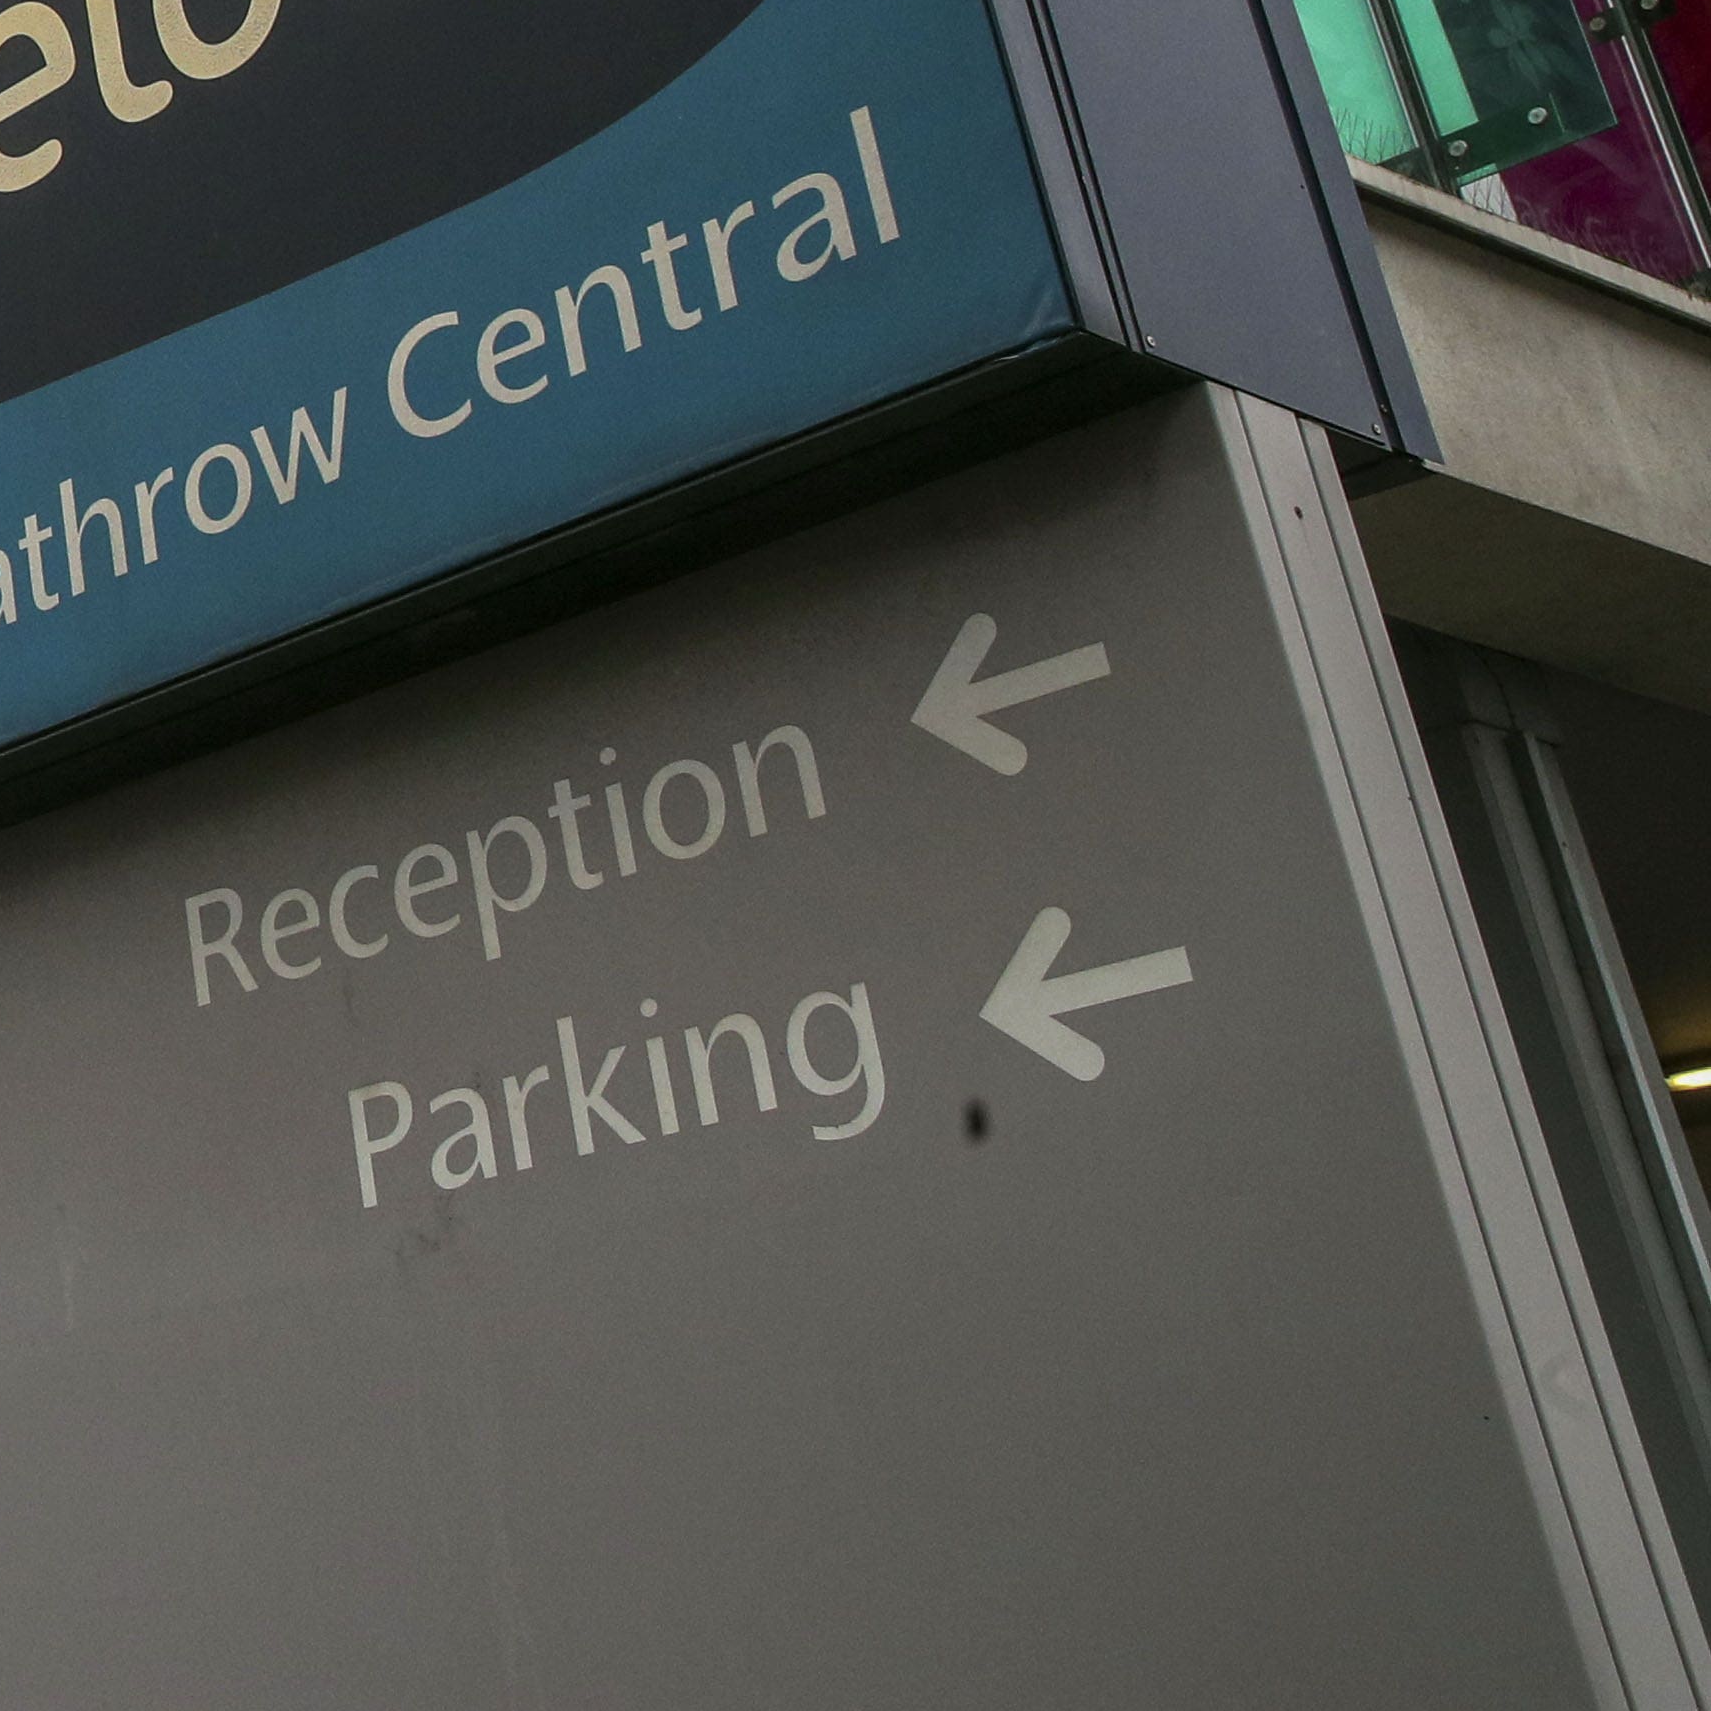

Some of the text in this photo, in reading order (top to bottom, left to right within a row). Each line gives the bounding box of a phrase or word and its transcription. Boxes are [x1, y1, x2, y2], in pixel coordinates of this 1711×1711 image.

[385, 106, 901, 440] Central
[182, 723, 827, 1009] Reception
[347, 979, 890, 1211] Parking
